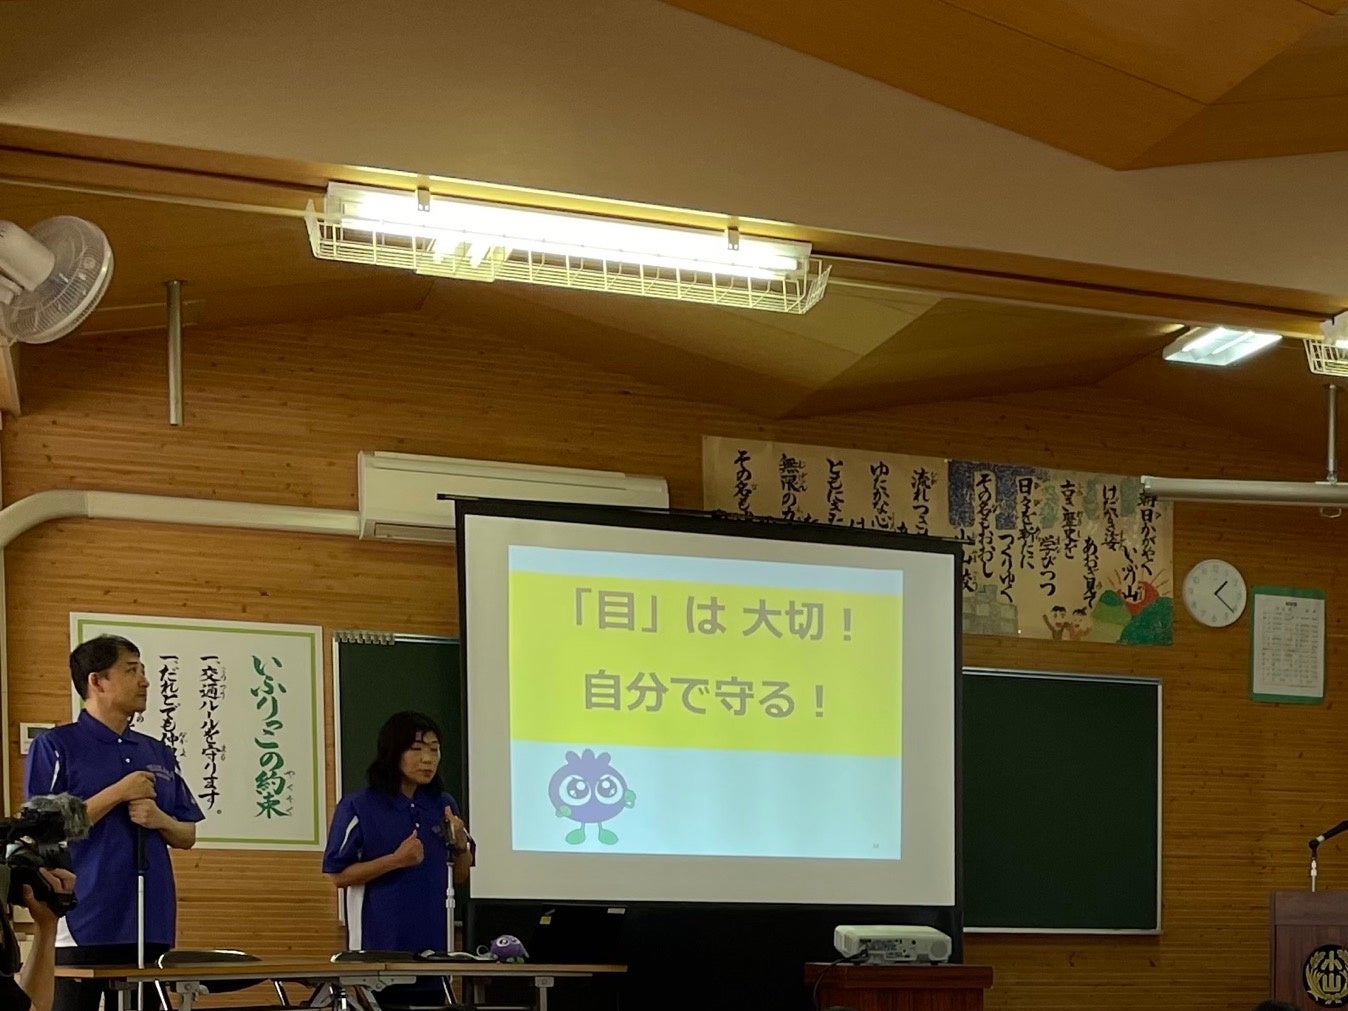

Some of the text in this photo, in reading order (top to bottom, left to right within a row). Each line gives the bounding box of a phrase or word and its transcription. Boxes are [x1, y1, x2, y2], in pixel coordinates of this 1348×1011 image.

[869, 461, 890, 528] ゆたかな心
[1059, 479, 1079, 560] 古き歴史を
[998, 534, 1016, 604] つくりゆく
[1039, 535, 1057, 597] 学びつつ
[574, 586, 727, 635] 「目」は
[583, 668, 826, 719] 自分で守る！
[199, 655, 222, 814] 一、交通ルールを守ります。
[250, 654, 290, 819] いふりっこの約束
[1320, 950, 1342, 992] 小山
